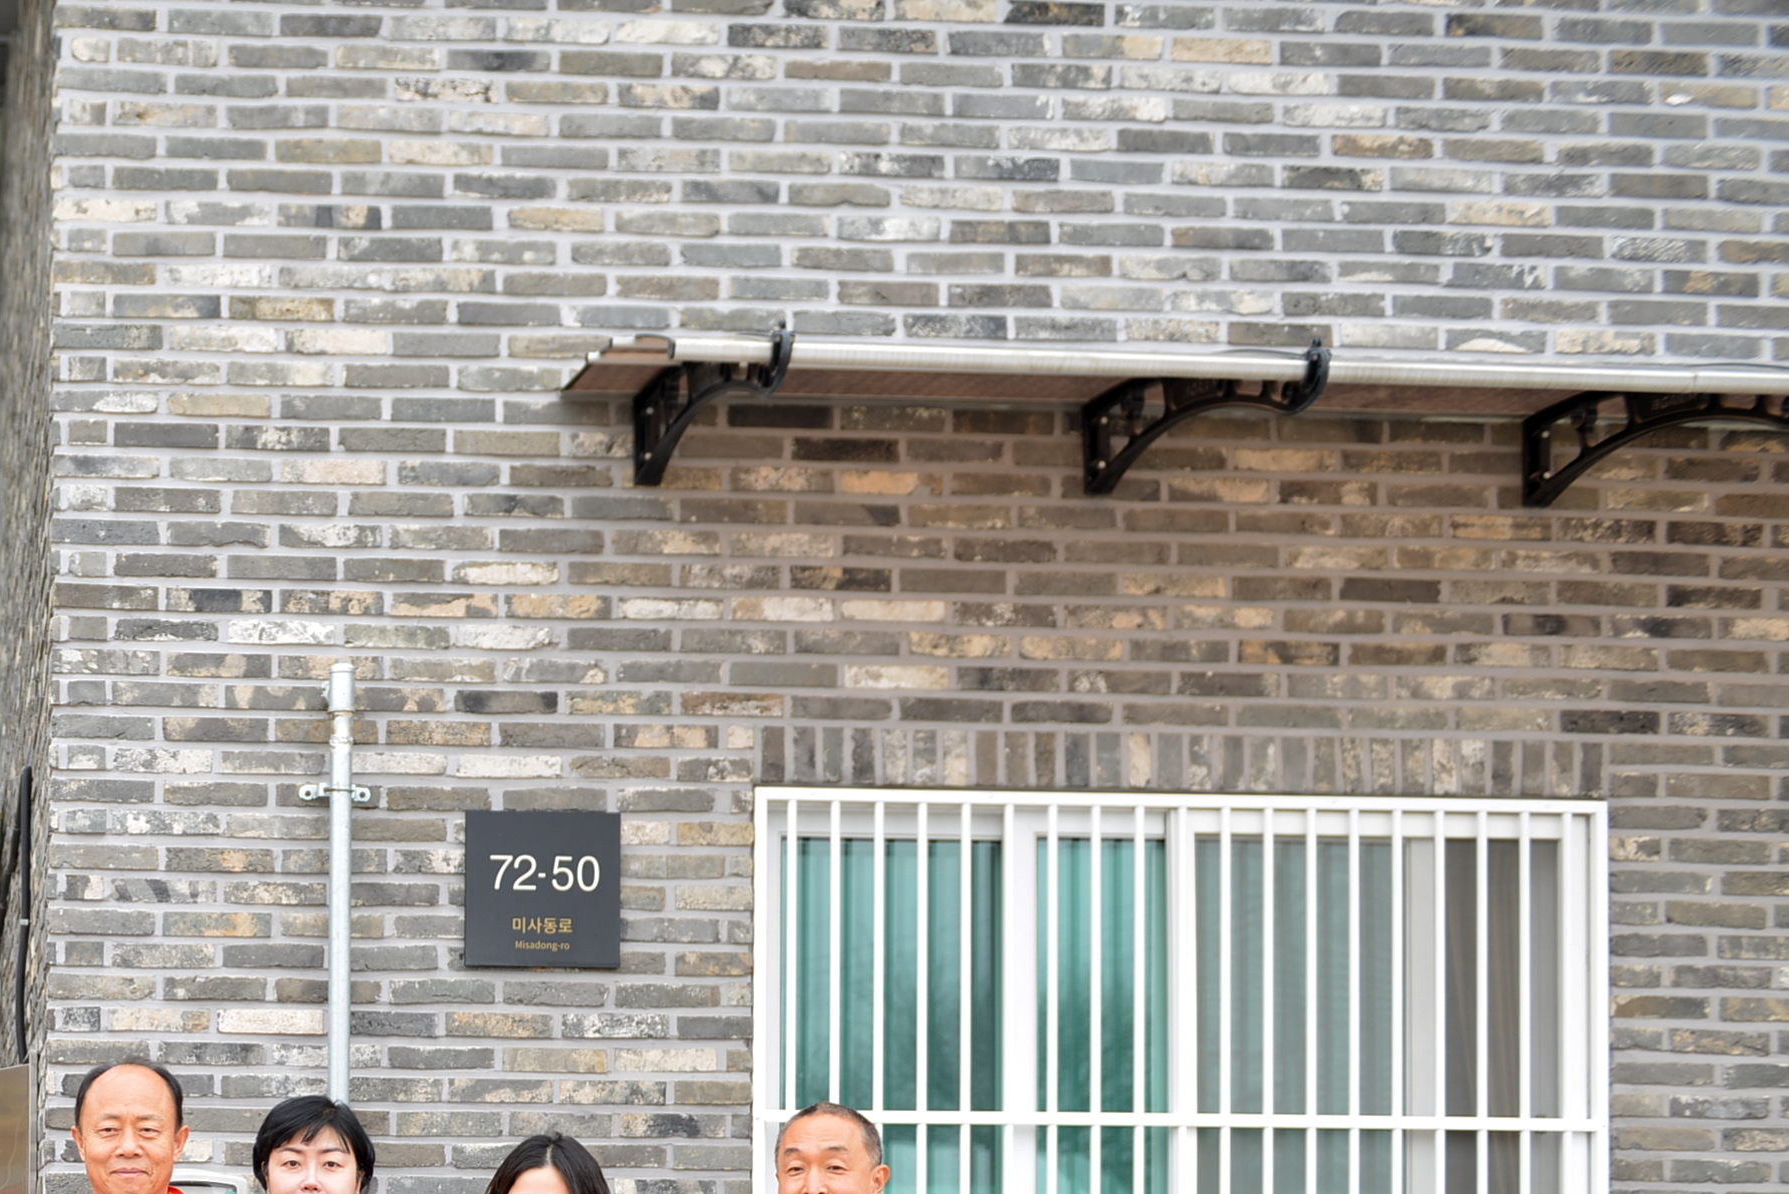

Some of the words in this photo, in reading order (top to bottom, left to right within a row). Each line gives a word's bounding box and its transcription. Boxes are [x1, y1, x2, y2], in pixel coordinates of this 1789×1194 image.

[489, 854, 600, 892] 72-50
[512, 917, 573, 935] 미사동로
[515, 940, 570, 952] Misadong-ro
